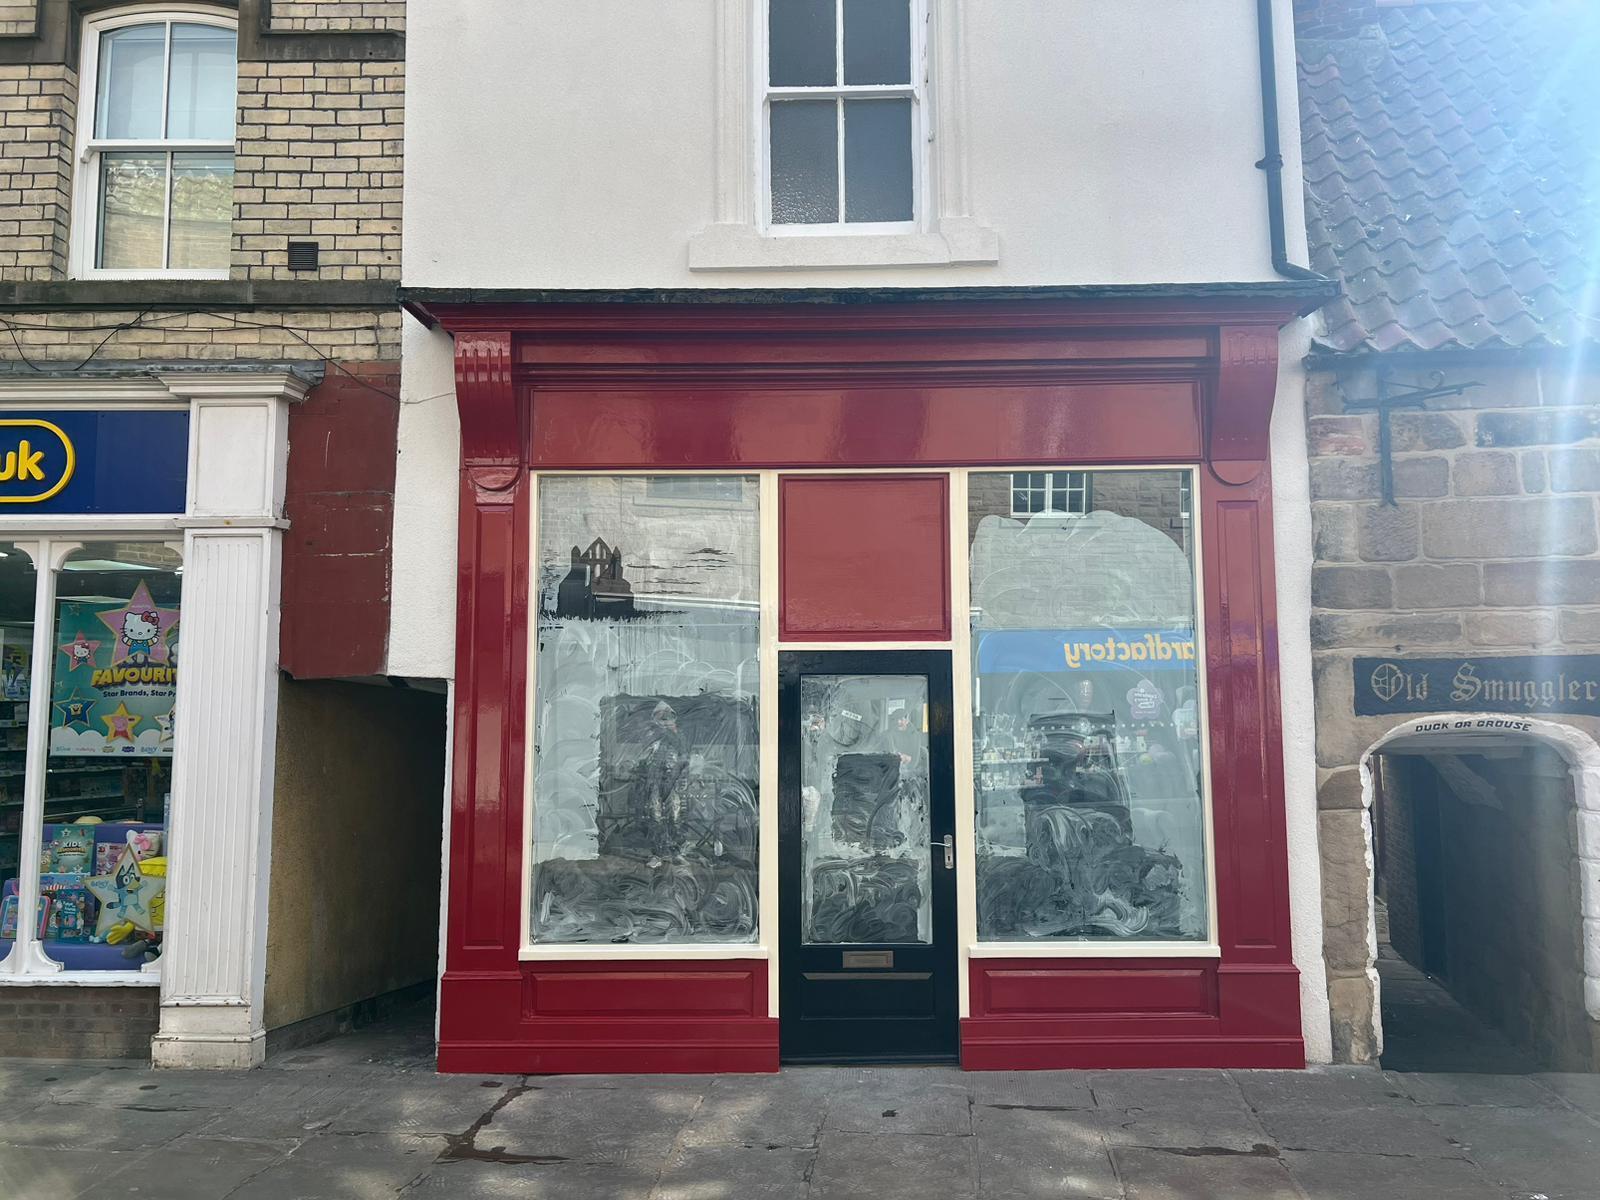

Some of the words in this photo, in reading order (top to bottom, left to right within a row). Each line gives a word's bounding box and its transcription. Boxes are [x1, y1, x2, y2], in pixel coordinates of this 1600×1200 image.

[1370, 663, 1430, 701] Old
[1450, 662, 1599, 708] Smuggler
[120, 689, 149, 697] Brands,
[150, 689, 167, 697] Star
[1415, 722, 1449, 732] DUCK
[1454, 721, 1472, 729] OR
[1476, 720, 1532, 732] GROUSE
